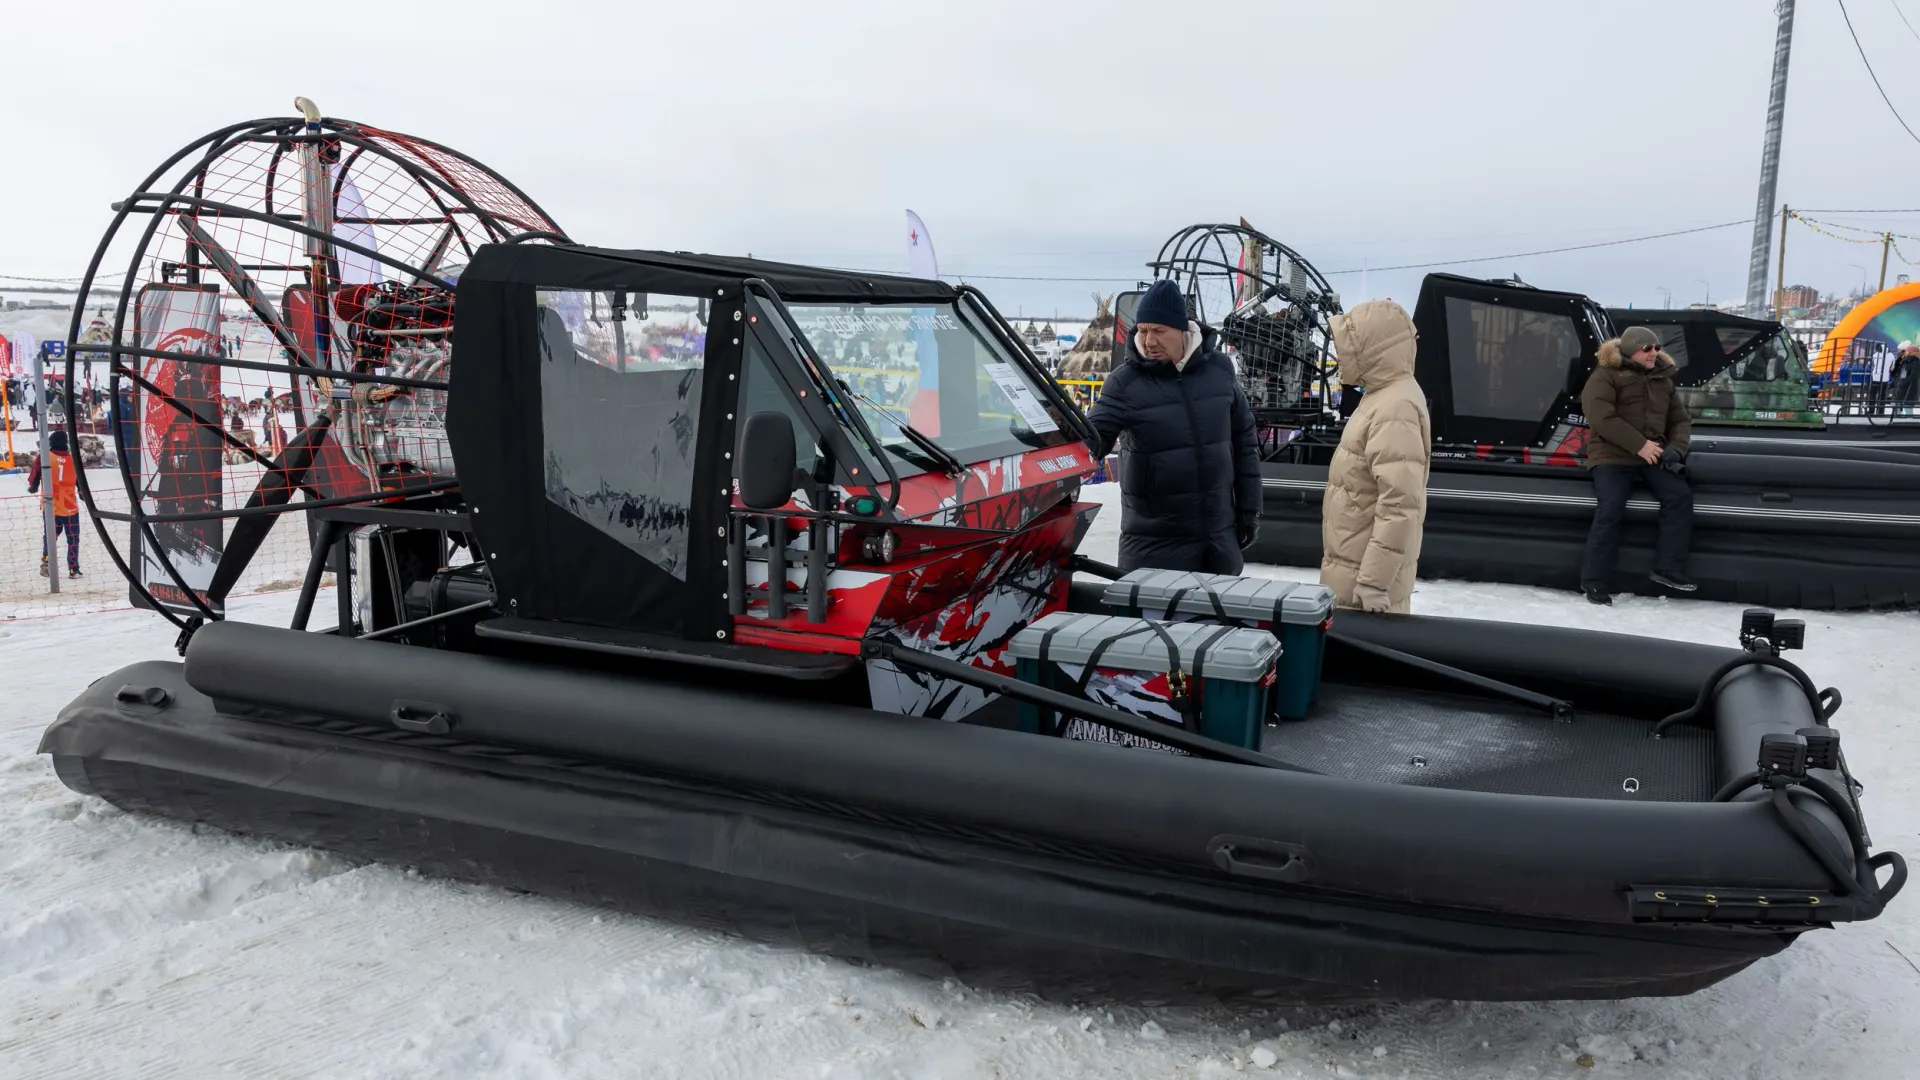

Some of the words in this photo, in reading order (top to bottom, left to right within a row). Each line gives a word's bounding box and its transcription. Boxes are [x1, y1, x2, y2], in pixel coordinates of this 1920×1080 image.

[910, 315, 958, 330] ЯМАЛЕ
[1755, 411, 1796, 419] SIBEX
[58, 464, 64, 481] 1
